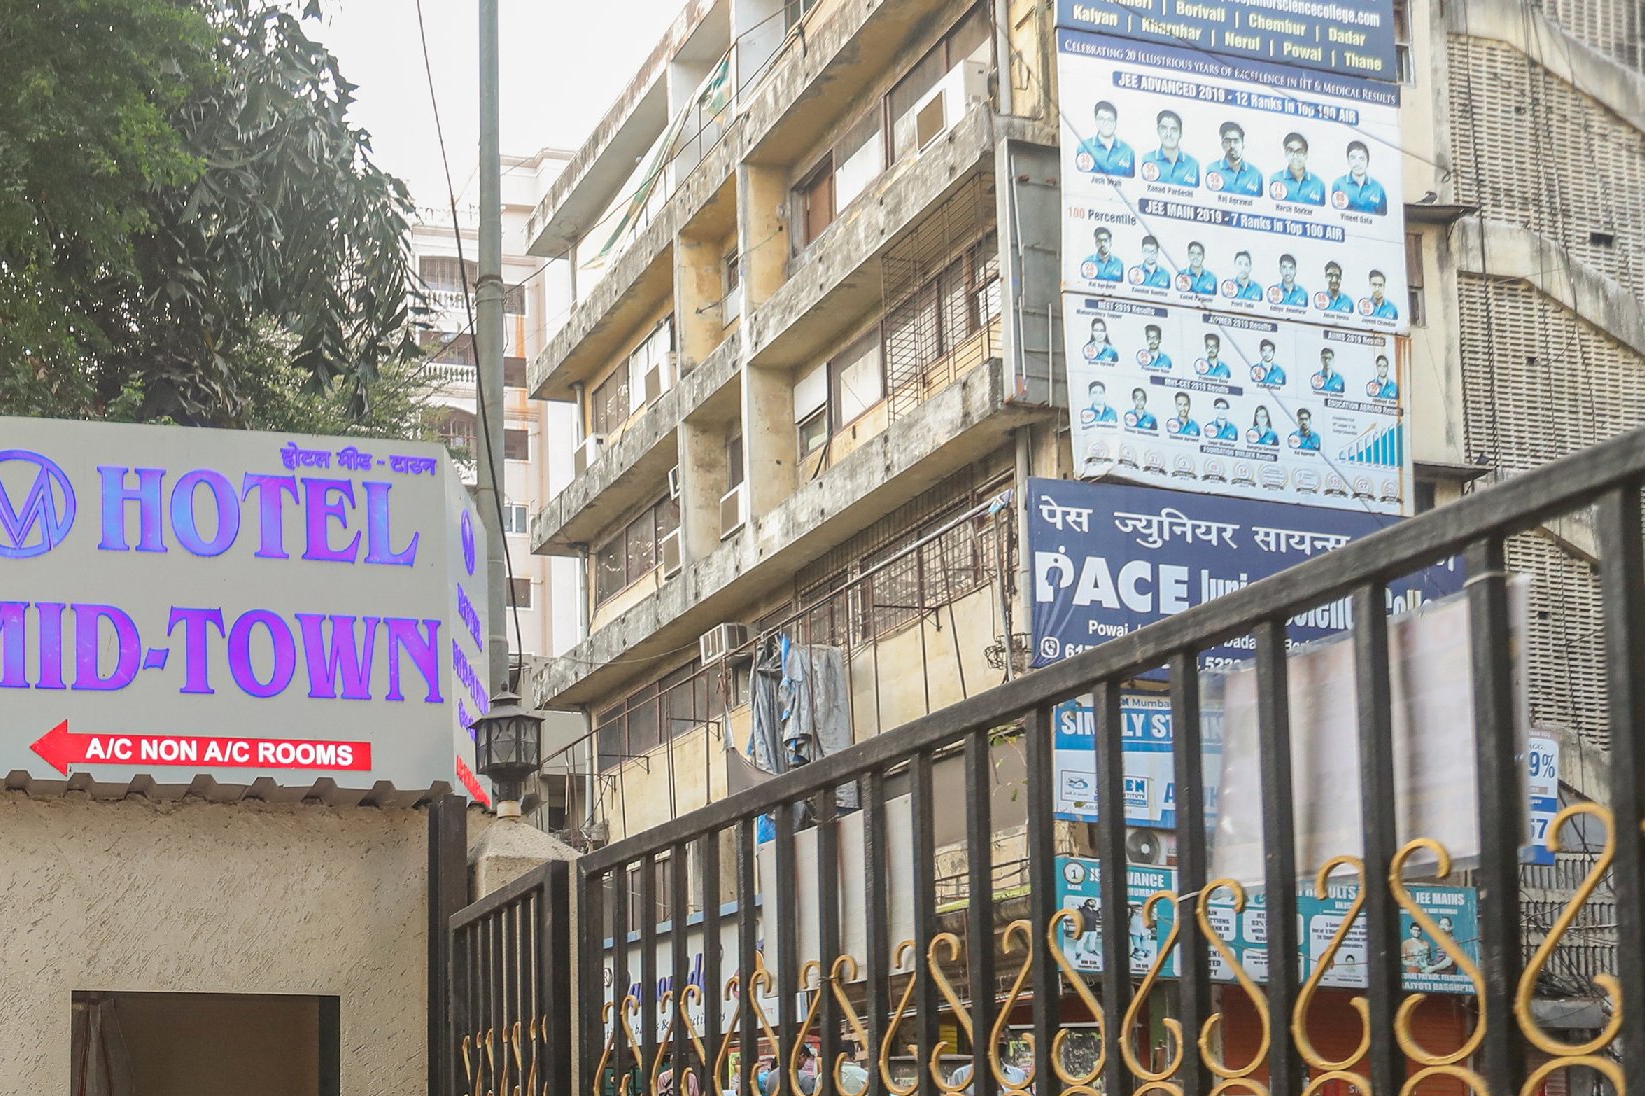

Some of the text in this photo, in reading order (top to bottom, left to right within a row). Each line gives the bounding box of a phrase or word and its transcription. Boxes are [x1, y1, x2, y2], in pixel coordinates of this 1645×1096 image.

[1073, 4, 1118, 27] Kalyan
[1224, 31, 1260, 51] Nerul
[1344, 51, 1383, 71] Thane
[1328, 26, 1366, 47] Dadar
[1118, 73, 1138, 88] JEE
[1140, 76, 1197, 97] ADVANCED
[1198, 86, 1225, 102] 2019
[1235, 90, 1248, 106] 12
[1251, 93, 1283, 111] Ranks
[1338, 108, 1356, 124] AIR
[1067, 207, 1137, 226] 100 Percentile
[1145, 200, 1165, 215] JEE
[1167, 203, 1194, 220] MAIN
[1196, 207, 1222, 224] 2019
[1231, 213, 1238, 226] 7
[1240, 214, 1271, 231] Ranks
[1326, 226, 1342, 240] AIR
[97, 464, 419, 568] HOTEL
[1038, 495, 1093, 533] पेस
[1034, 546, 1190, 615] PACE
[85, 738, 354, 766] A/C NON A/C ROOMS
[1415, 891, 1465, 906] JEE MAINS
